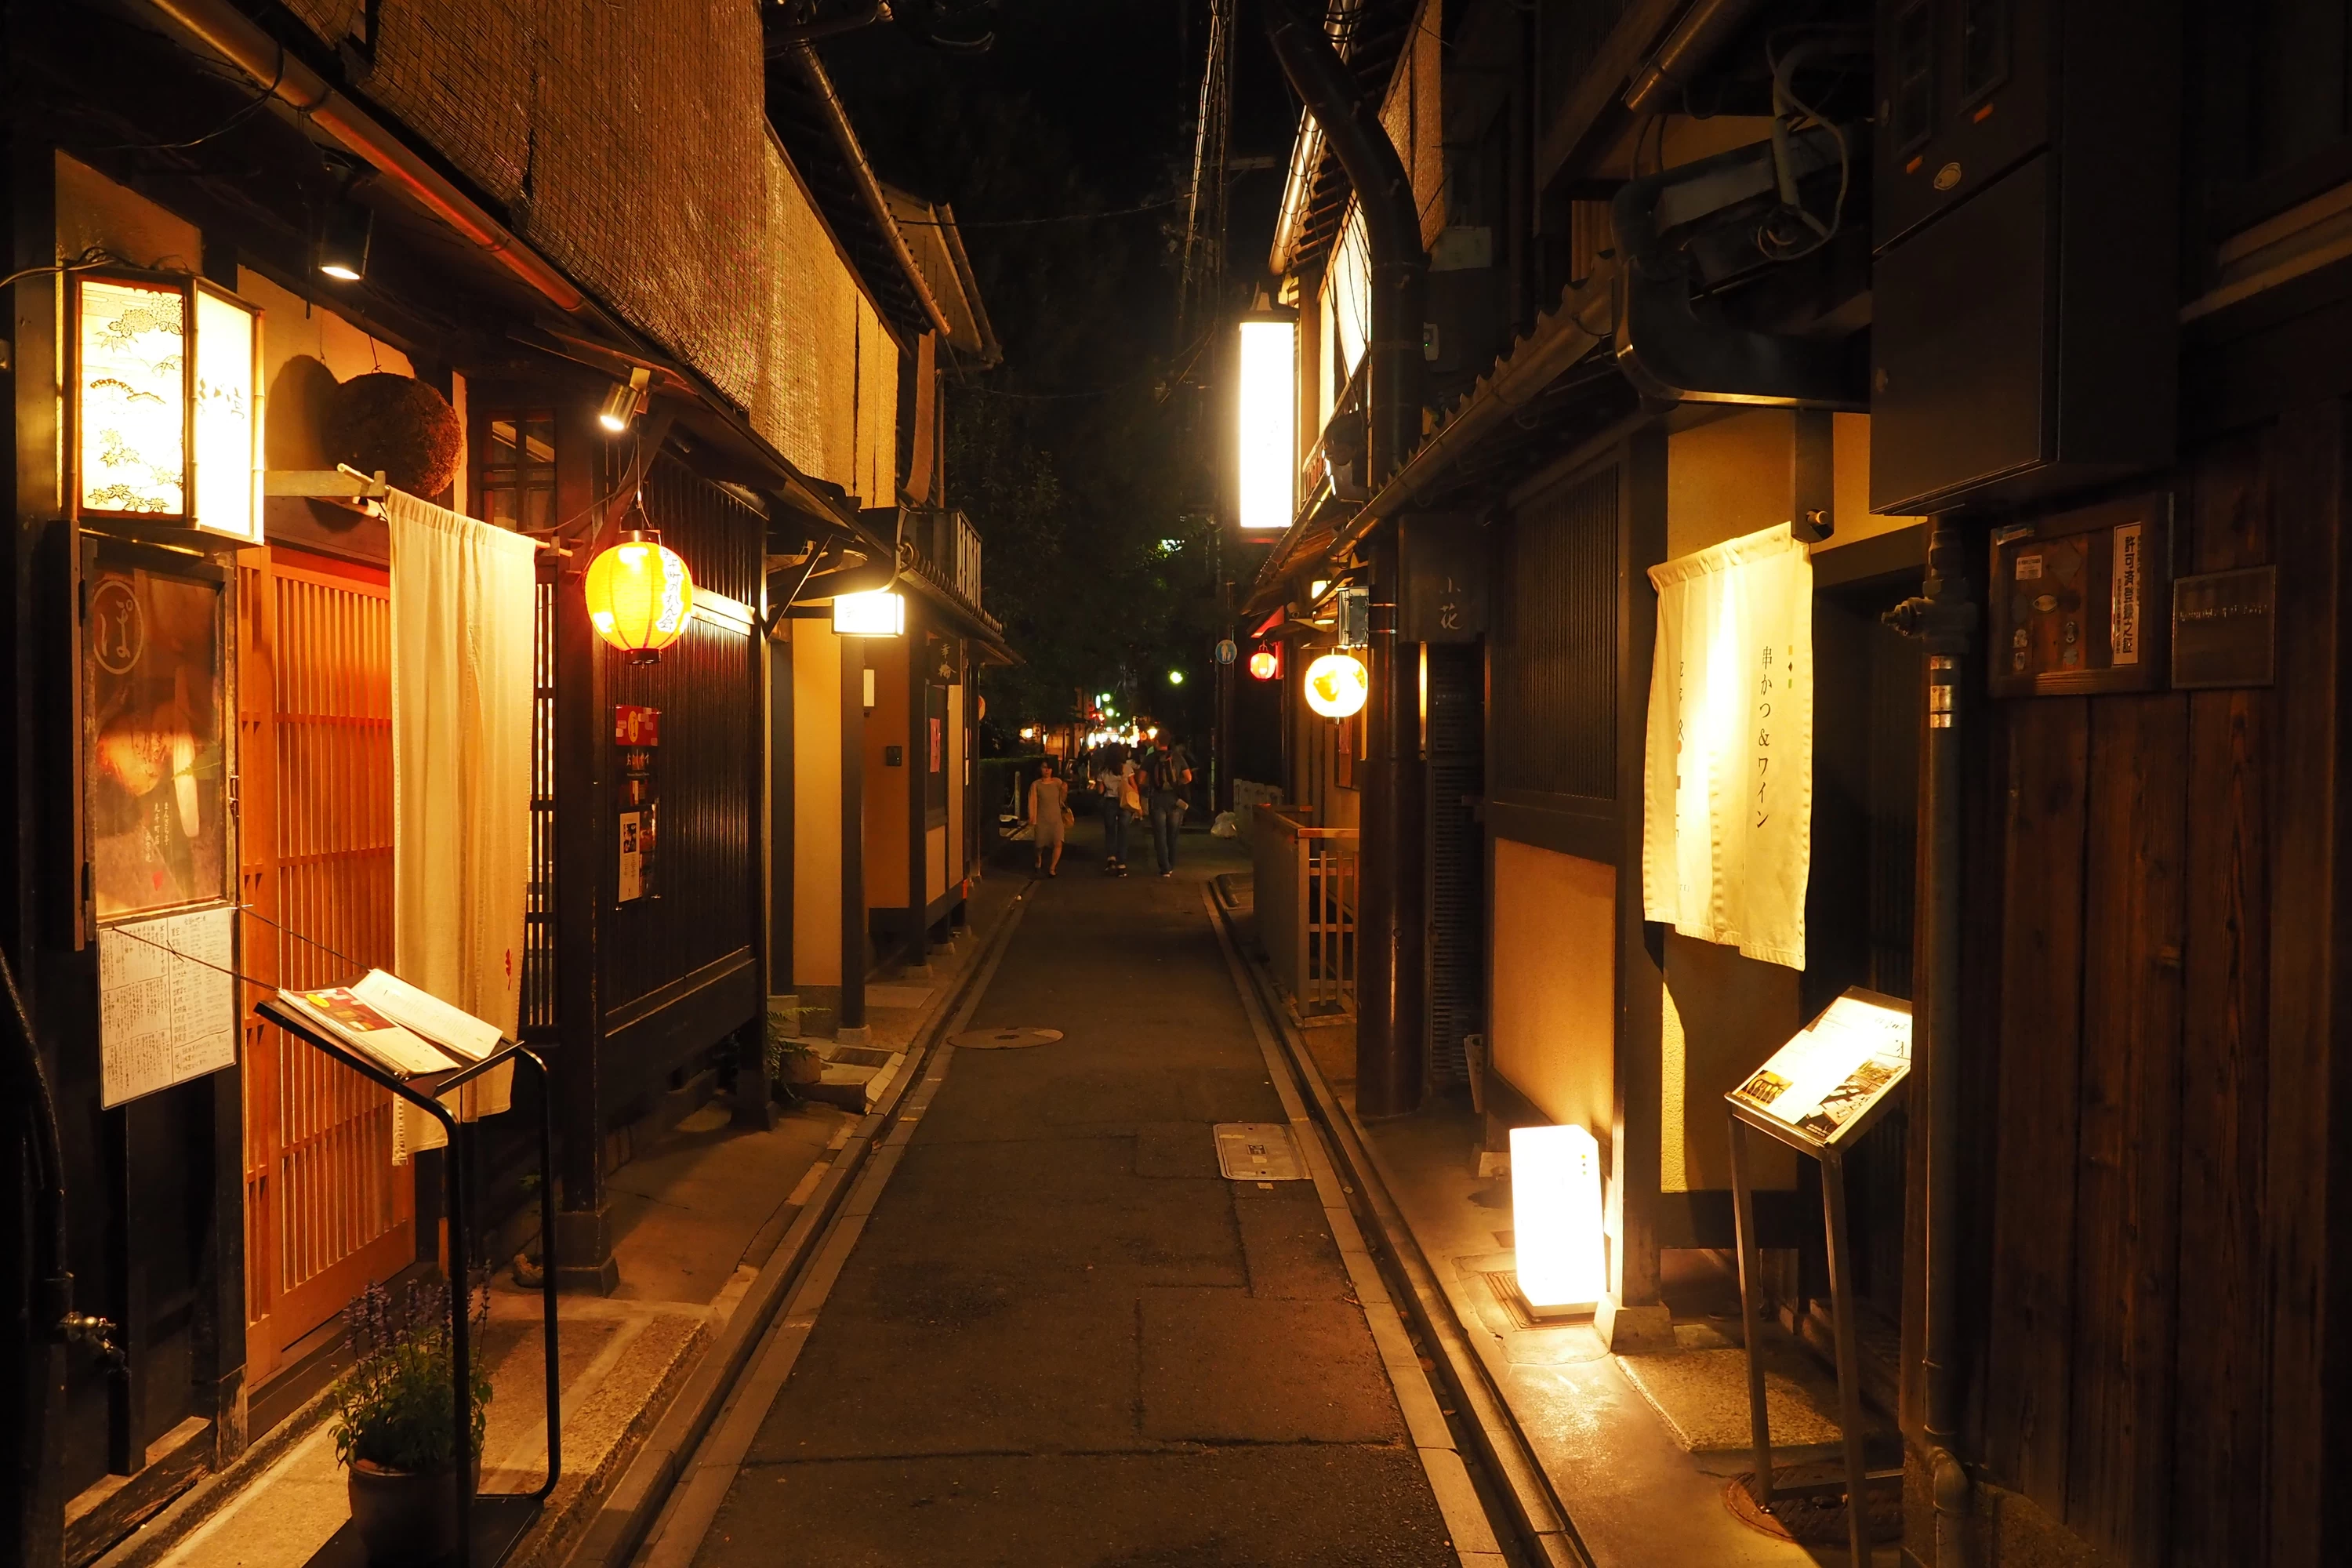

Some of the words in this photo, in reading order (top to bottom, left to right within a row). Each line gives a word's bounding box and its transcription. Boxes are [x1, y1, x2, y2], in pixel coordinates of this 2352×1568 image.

[1439, 576, 1463, 630] 小花
[1756, 645, 1773, 829] 串かつ&ワイン
